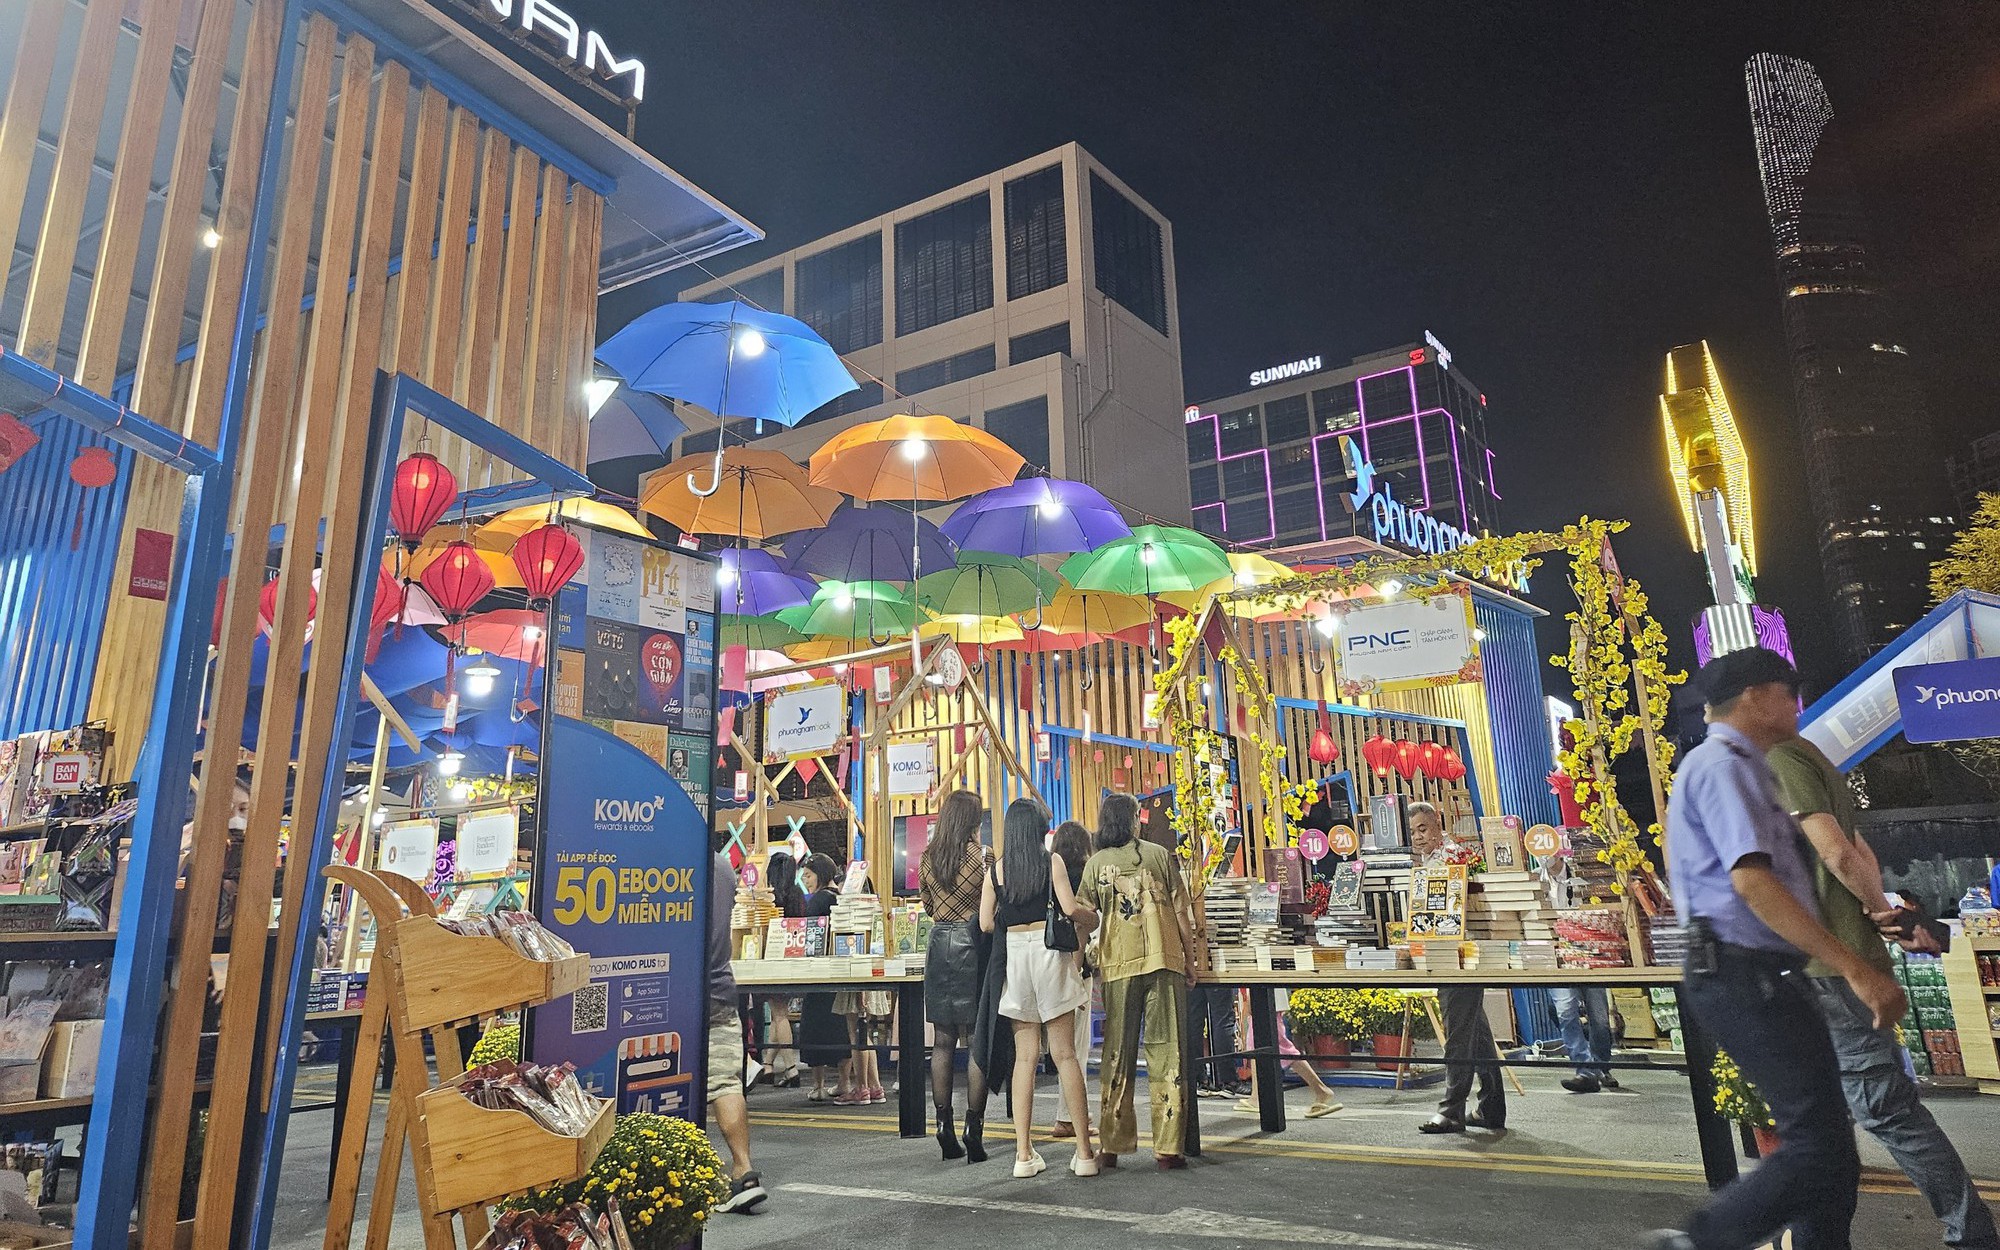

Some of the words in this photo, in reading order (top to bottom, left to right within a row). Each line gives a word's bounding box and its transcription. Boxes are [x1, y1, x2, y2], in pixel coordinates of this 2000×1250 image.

[490, 0, 645, 101] AM
[1250, 355, 1322, 386] SUNWAH
[1348, 629, 1410, 650] PNC
[1935, 688, 2000, 710] phuon
[56, 765, 78, 773] BAN
[893, 760, 922, 772] KOMO
[55, 772, 73, 781] DAI
[594, 798, 656, 823] KOMO
[594, 823, 622, 832] rewards
[629, 823, 654, 832] ebooks
[1331, 833, 1353, 849] -20
[1528, 833, 1555, 850] -20
[557, 850, 569, 863] TẢI
[570, 853, 586, 863] APP
[587, 849, 599, 863] ĐỂ
[599, 853, 617, 866] ĐỌC
[618, 867, 695, 894] EBOOK
[553, 865, 617, 926] 50
[618, 893, 661, 924] MIỄN
[665, 896, 695, 923] PHÍ
[612, 960, 638, 971] KOMO
[639, 958, 657, 969] PLUS
[1910, 969, 1933, 977] Sprite
[647, 987, 660, 995] Store
[1913, 990, 1936, 998] Sprite
[636, 1012, 654, 1021] Google
[653, 1011, 663, 1020] Play
[1921, 1012, 1944, 1020] Sprite
